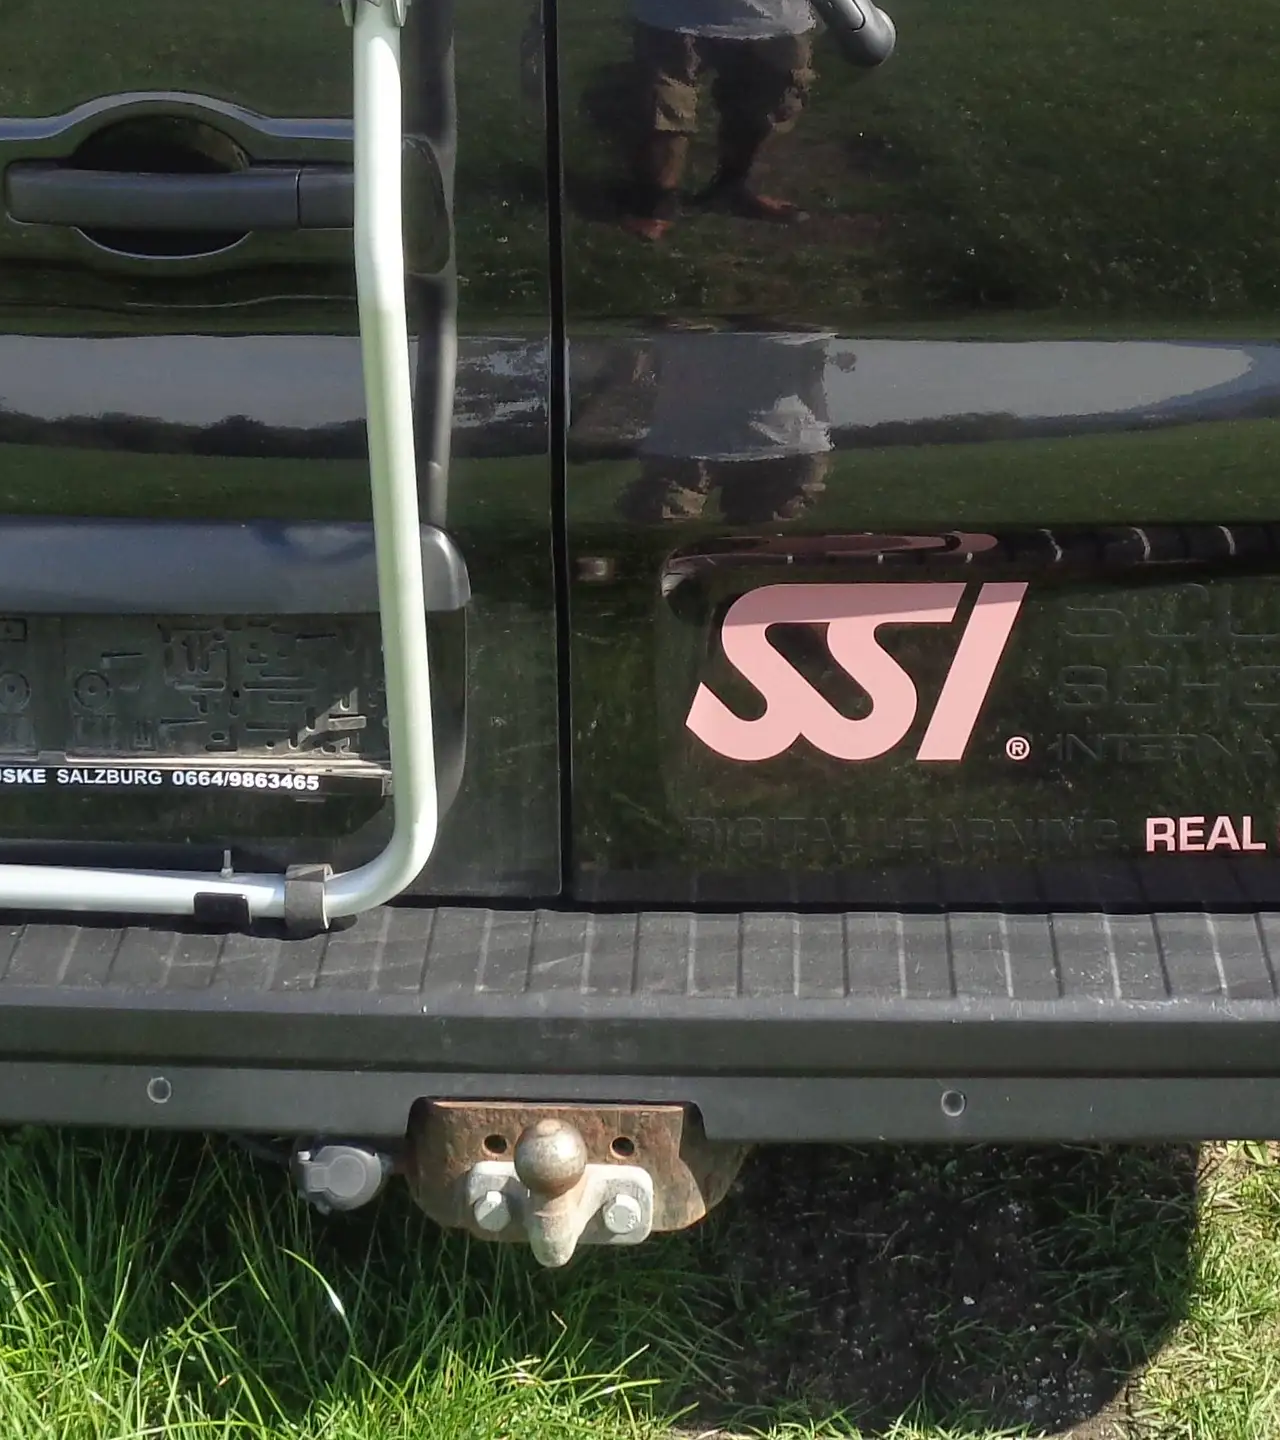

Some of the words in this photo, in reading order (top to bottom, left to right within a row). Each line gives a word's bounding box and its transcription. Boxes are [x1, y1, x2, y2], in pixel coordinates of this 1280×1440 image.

[685, 582, 1029, 760] SSI
[56, 768, 163, 786] SALZBURG
[171, 771, 320, 791] 0664/9863465
[1146, 816, 1267, 852] REAL
